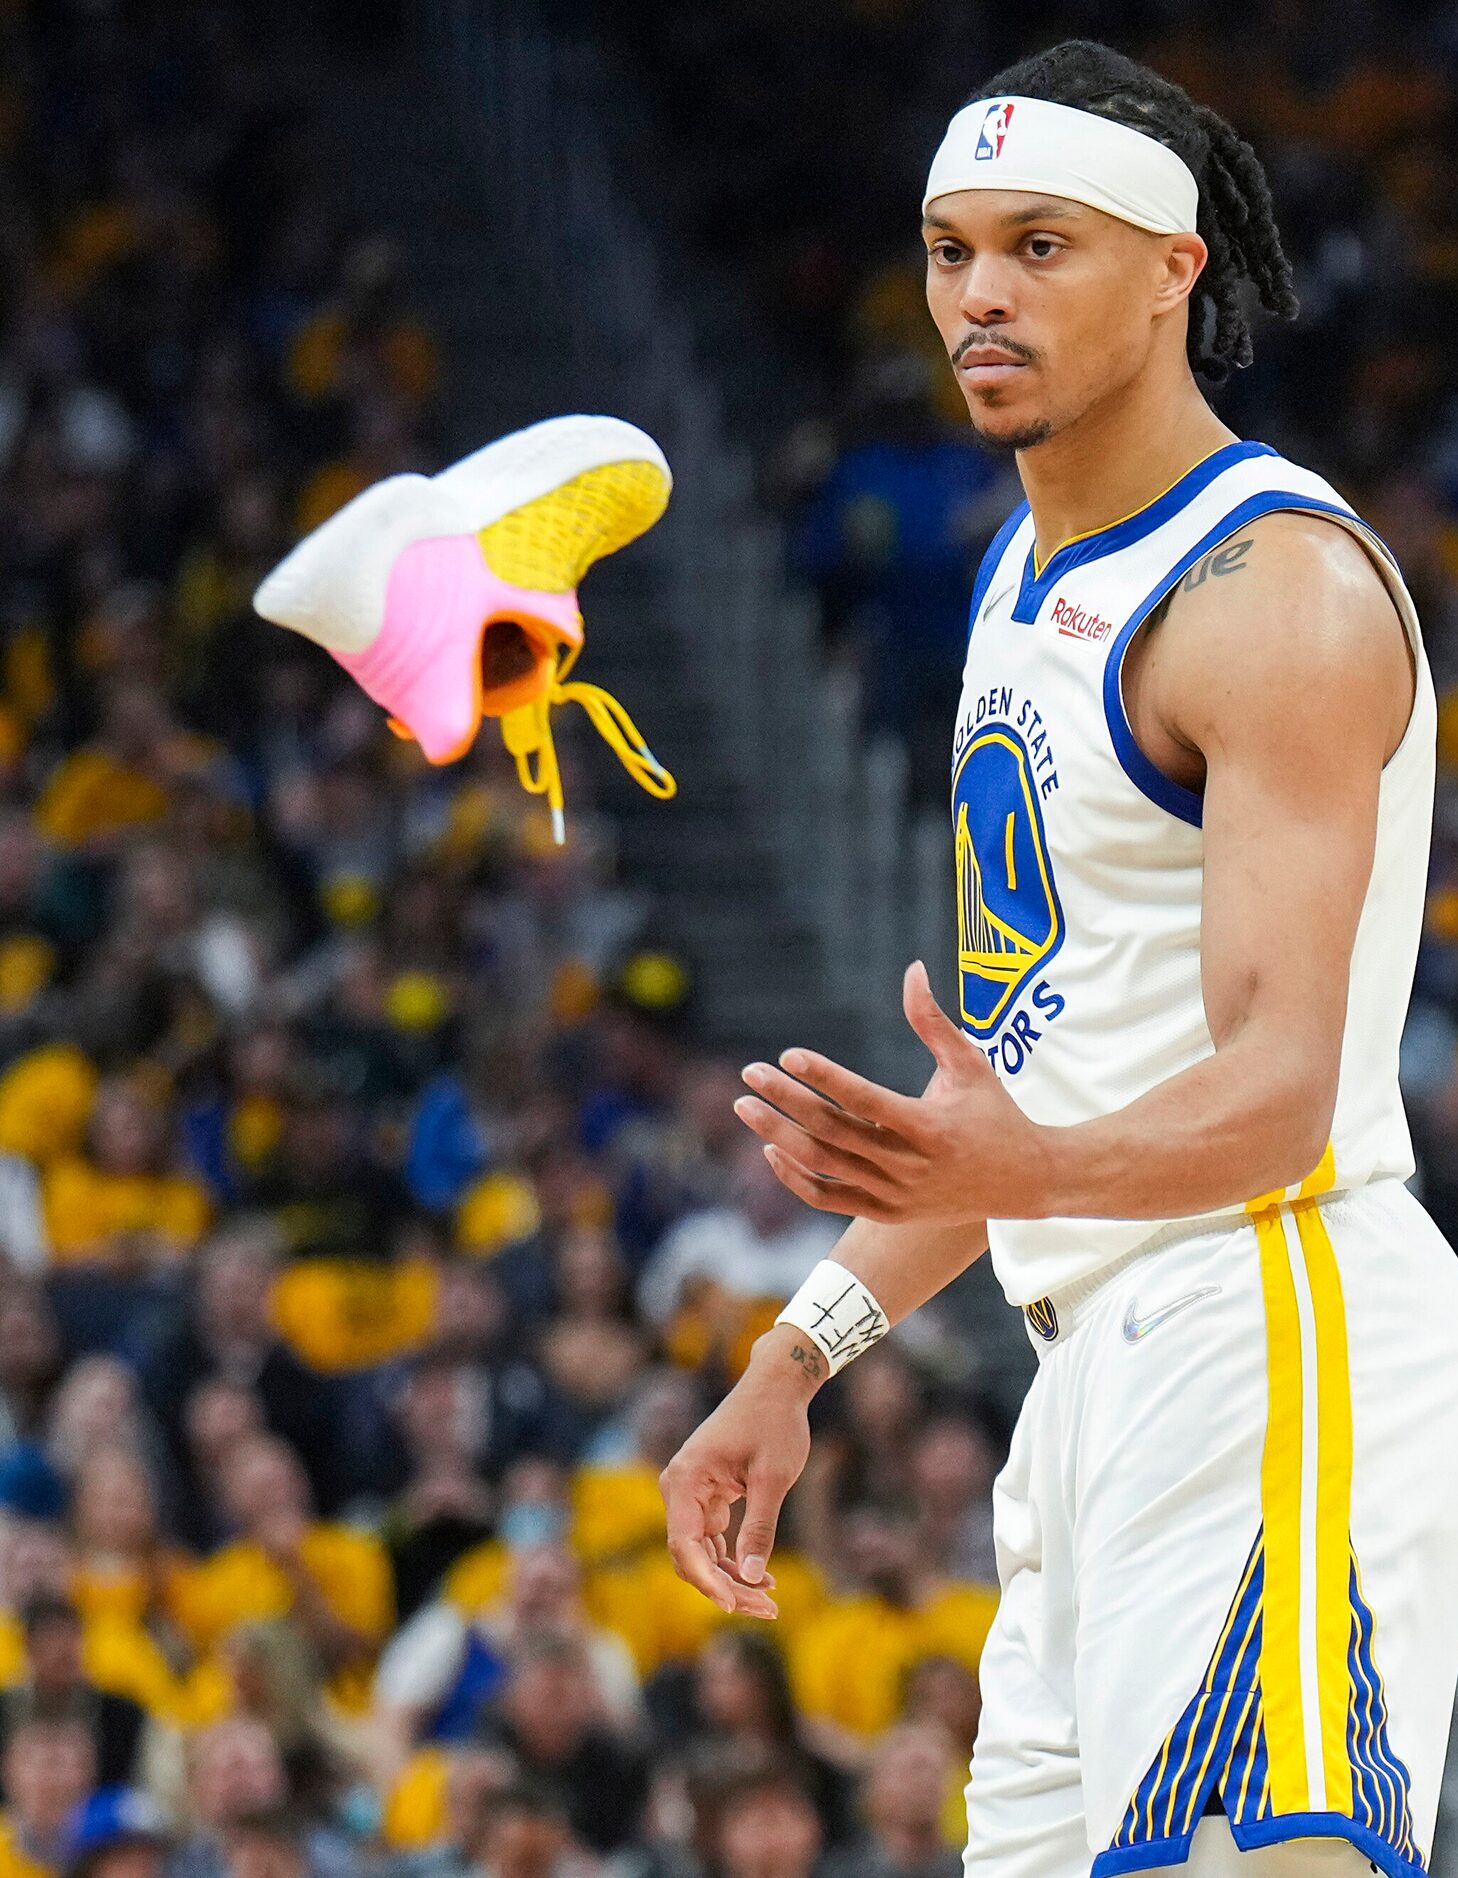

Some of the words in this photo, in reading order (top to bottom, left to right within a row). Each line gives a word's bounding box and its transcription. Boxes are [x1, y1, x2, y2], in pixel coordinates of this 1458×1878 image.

[1049, 597, 1112, 643] Rakuten
[953, 686, 1013, 768] OLDEN
[1017, 699, 1059, 800] STATE
